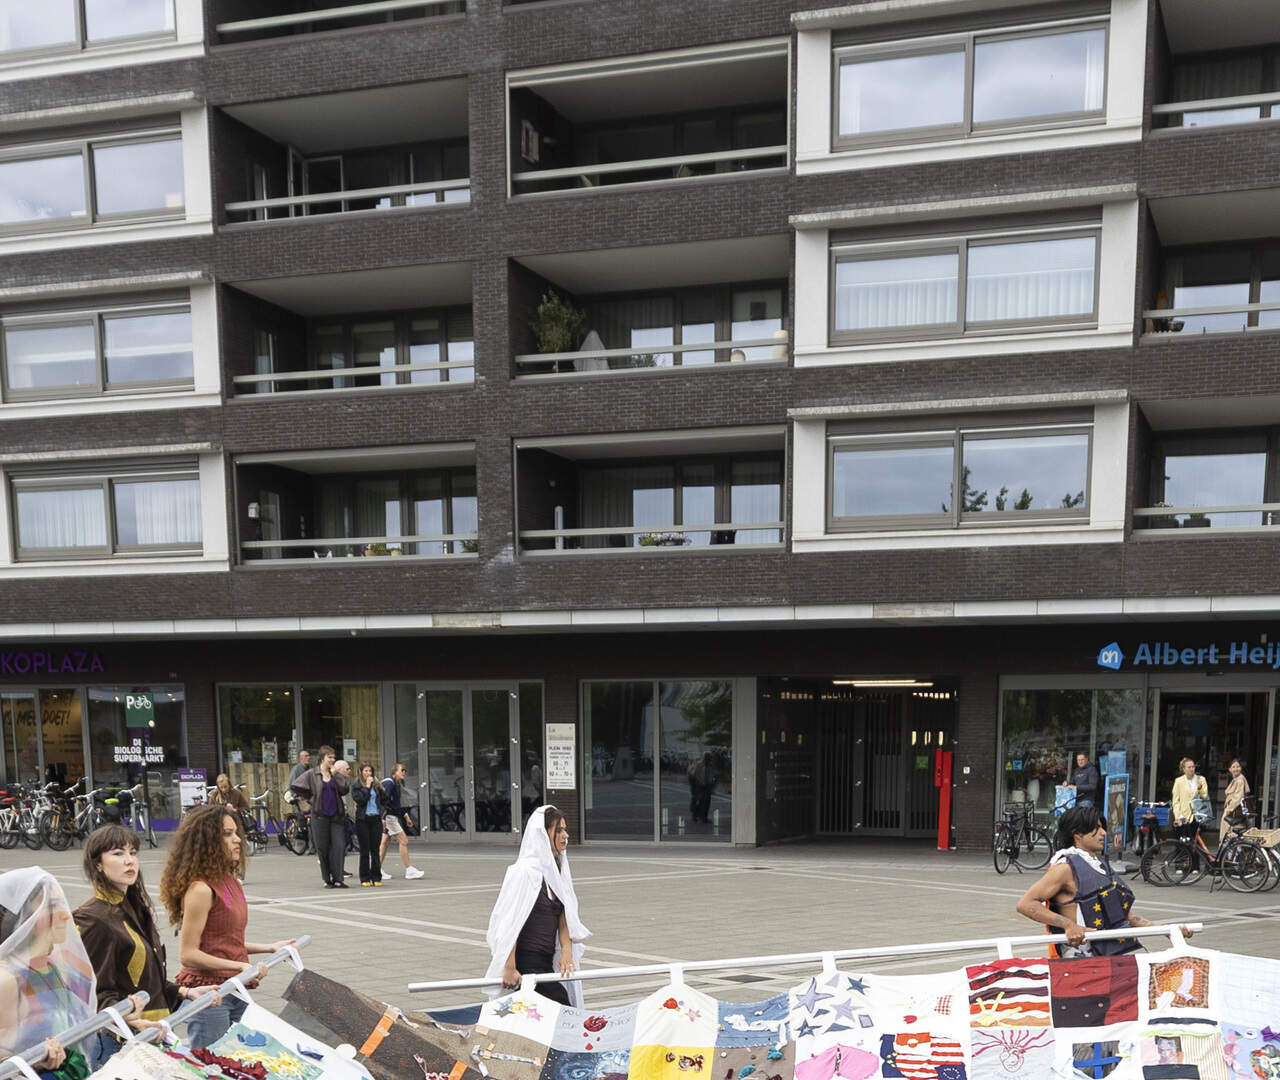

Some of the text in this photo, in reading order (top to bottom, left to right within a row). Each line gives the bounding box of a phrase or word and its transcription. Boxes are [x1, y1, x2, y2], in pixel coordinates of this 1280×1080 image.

[1133, 642, 1219, 665] Albert
[127, 695, 135, 709] P
[114, 746, 164, 754] BIOLOGSCHE
